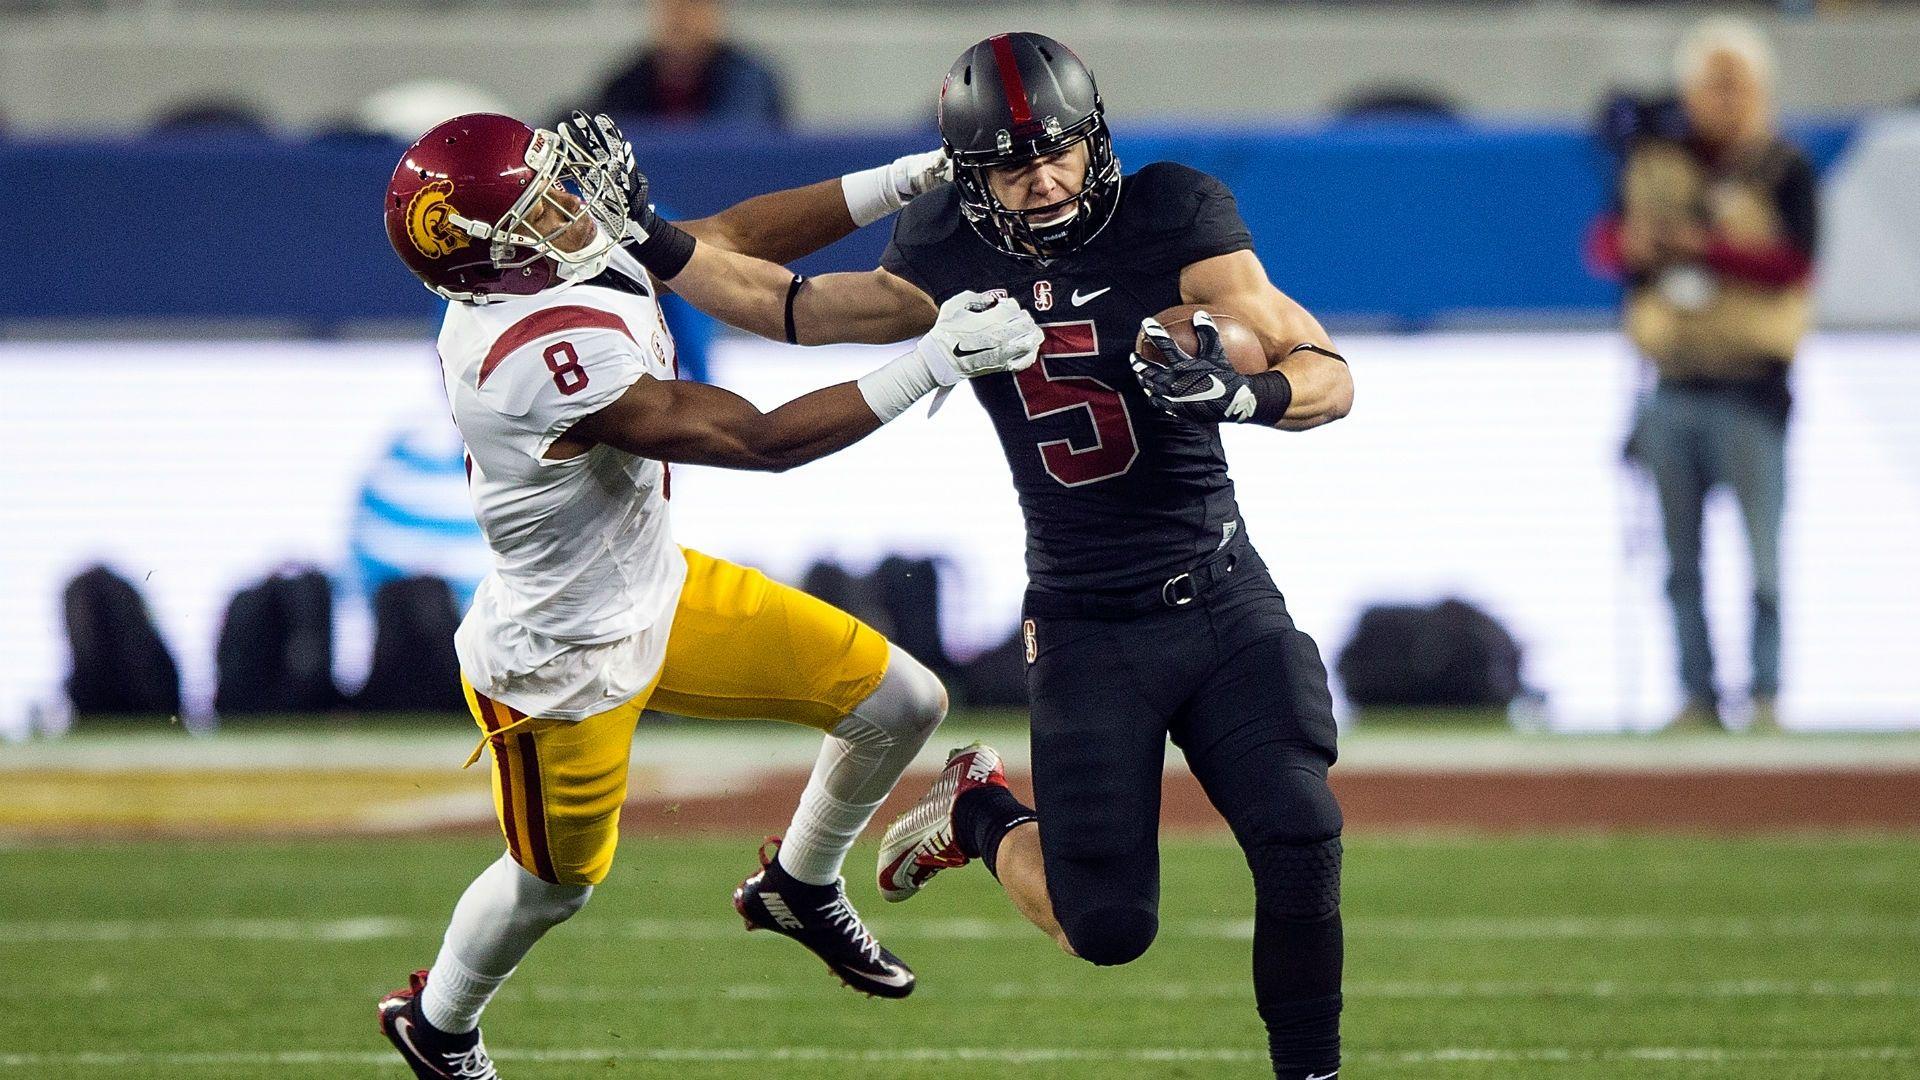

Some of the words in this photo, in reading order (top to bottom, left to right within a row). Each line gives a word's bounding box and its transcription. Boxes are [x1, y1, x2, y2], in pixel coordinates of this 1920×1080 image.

[1033, 280, 1053, 311] S
[542, 341, 589, 396] 8
[1012, 319, 1140, 488] 5
[758, 892, 804, 930] NIKE
